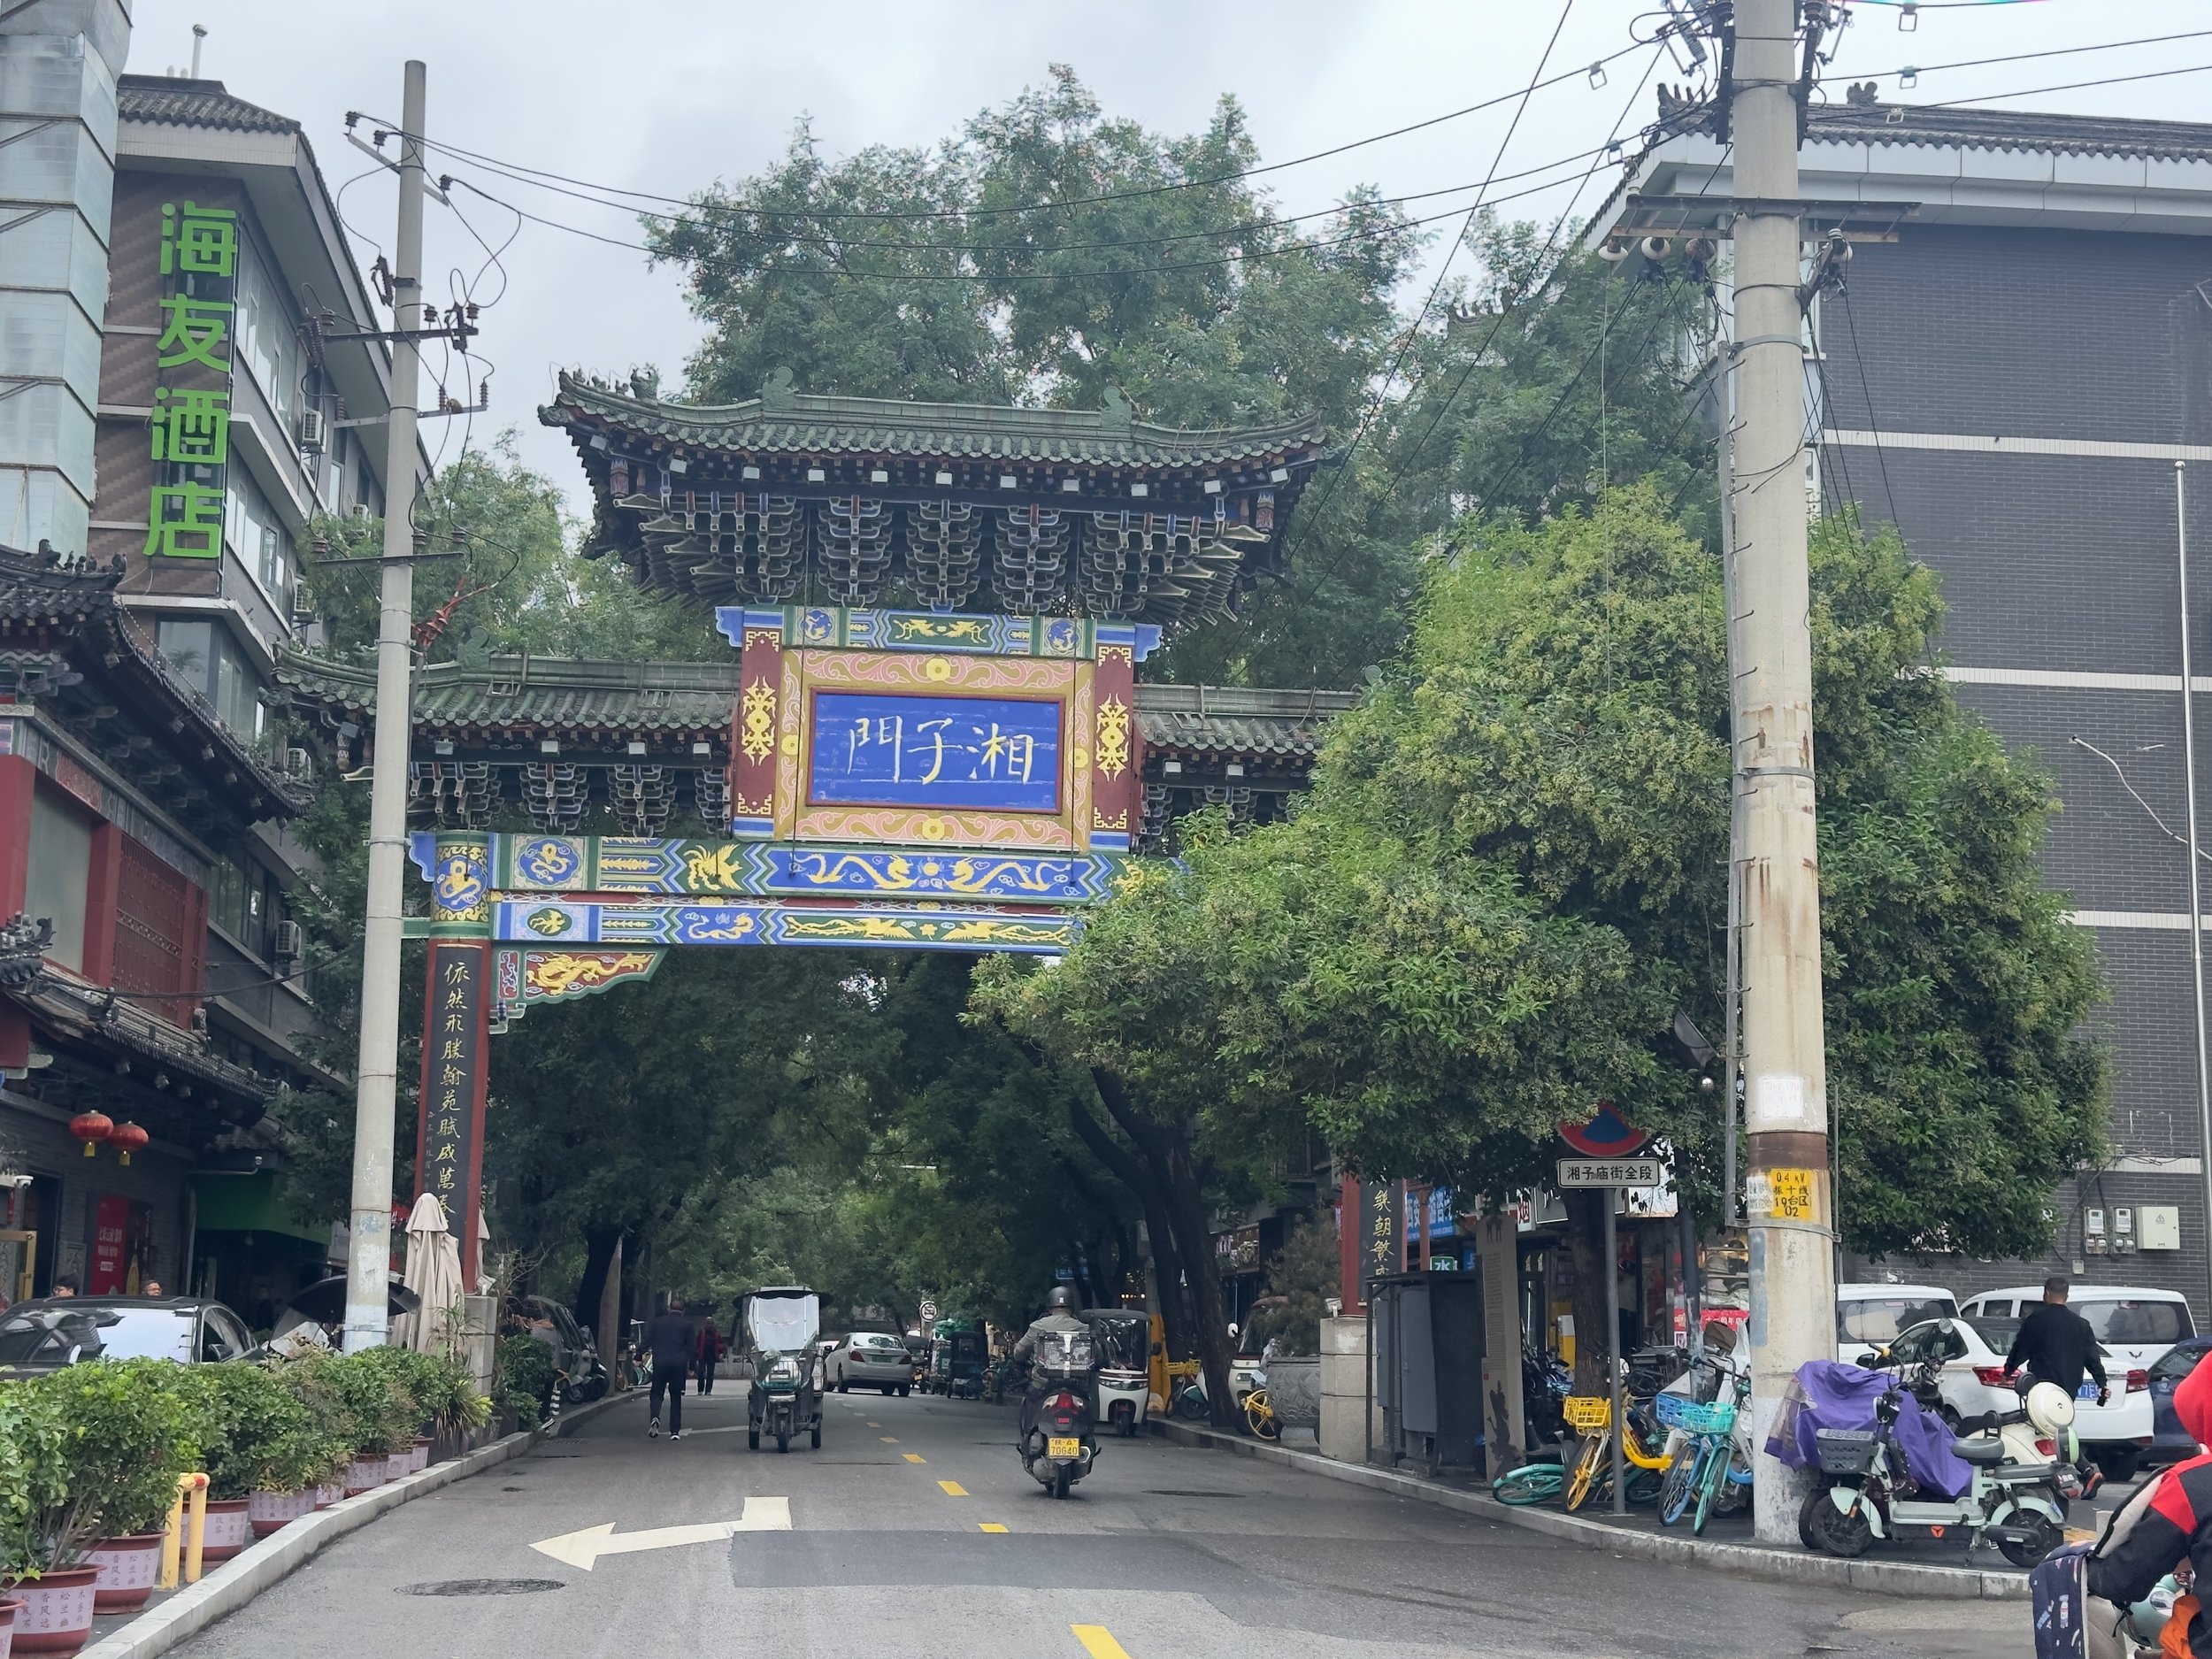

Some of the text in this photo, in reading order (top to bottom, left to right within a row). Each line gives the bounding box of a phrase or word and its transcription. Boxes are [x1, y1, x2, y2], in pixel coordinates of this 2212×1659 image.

[143, 200, 238, 559] 海友酒店
[1567, 1165, 1653, 1181] 湘子庙街全段
[1785, 1206, 1799, 1217] 02
